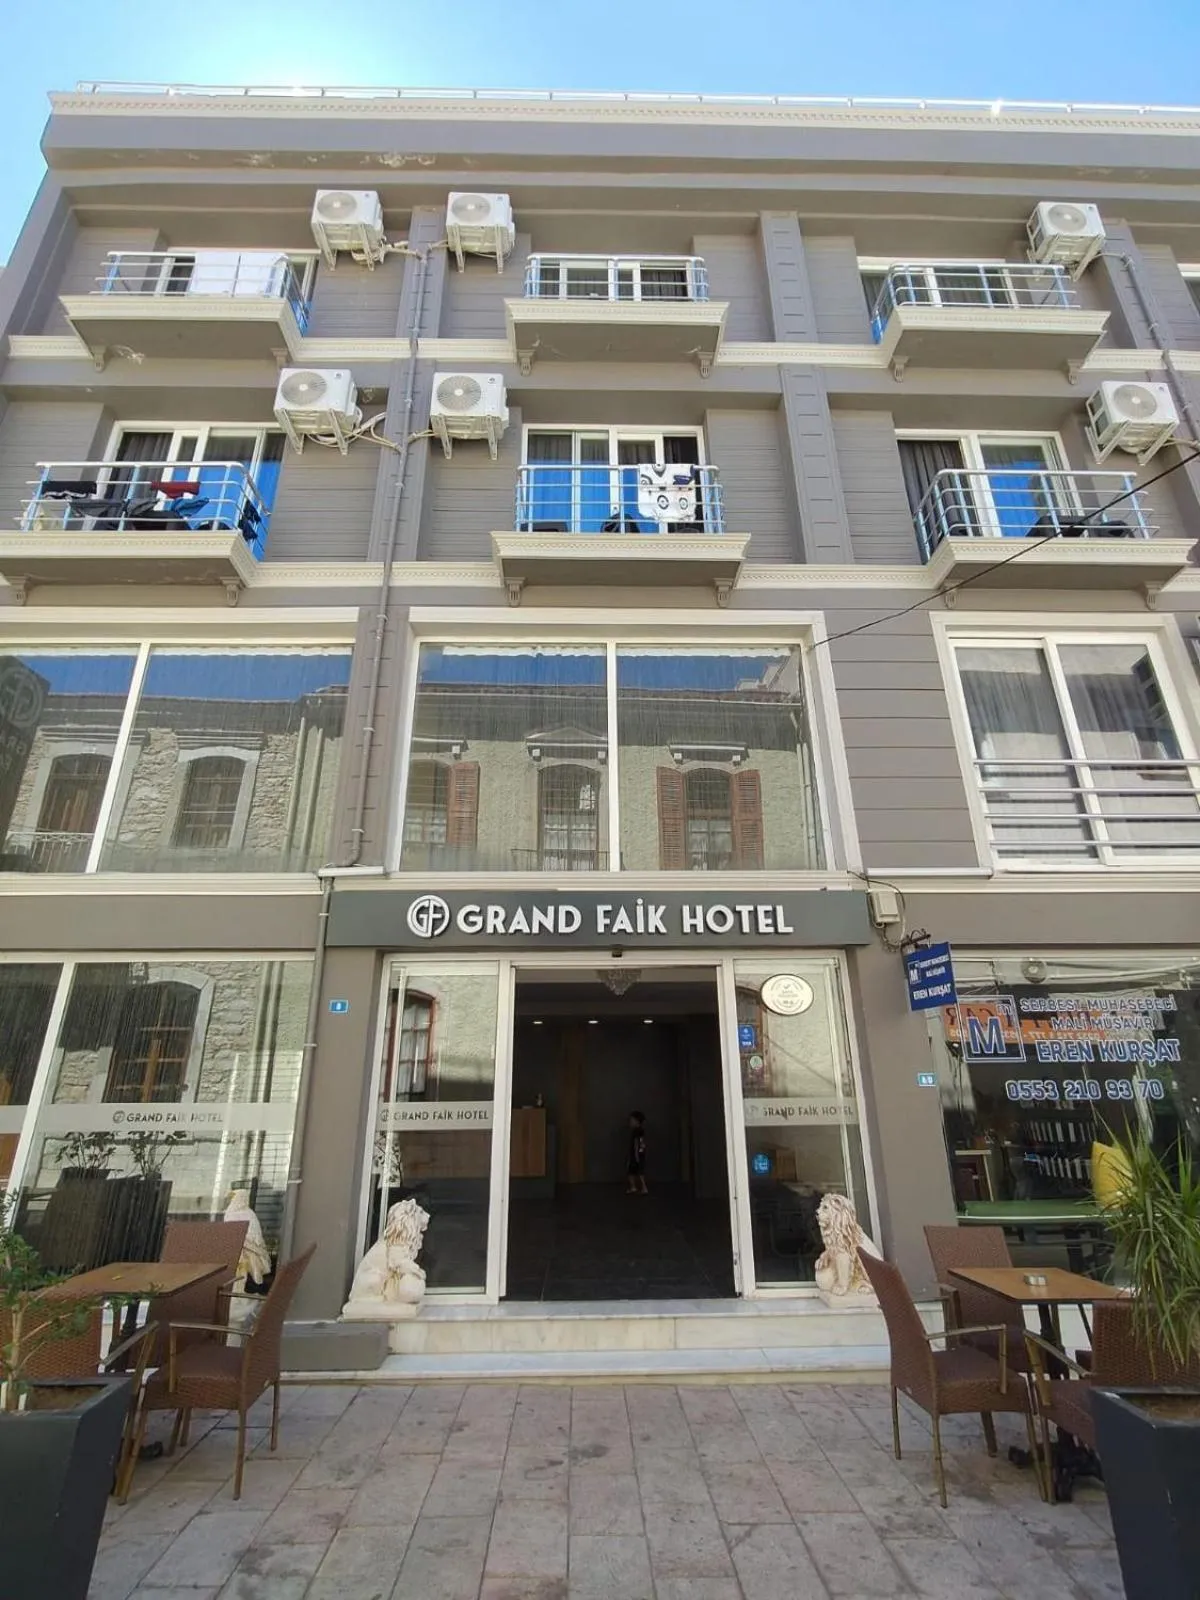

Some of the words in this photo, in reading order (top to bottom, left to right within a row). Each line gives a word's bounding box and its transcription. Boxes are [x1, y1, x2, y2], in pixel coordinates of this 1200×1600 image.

[456, 904, 582, 935] GRAND
[596, 898, 667, 934] FAİK
[682, 904, 794, 934] HOTEL
[966, 1016, 1007, 1054] M
[1036, 1039, 1094, 1062] EREN
[1098, 1038, 1181, 1068] KURŞAT
[1006, 1080, 1060, 1100] 0553
[1063, 1079, 1102, 1100] 210
[1105, 1080, 1134, 1099] 93
[1138, 1079, 1164, 1099] 70
[127, 1112, 163, 1122] GRAND
[393, 1112, 429, 1121] GRAND
[432, 1109, 453, 1120] FAİK
[456, 1110, 489, 1120] HOTEL
[822, 1106, 853, 1116] HOEL
